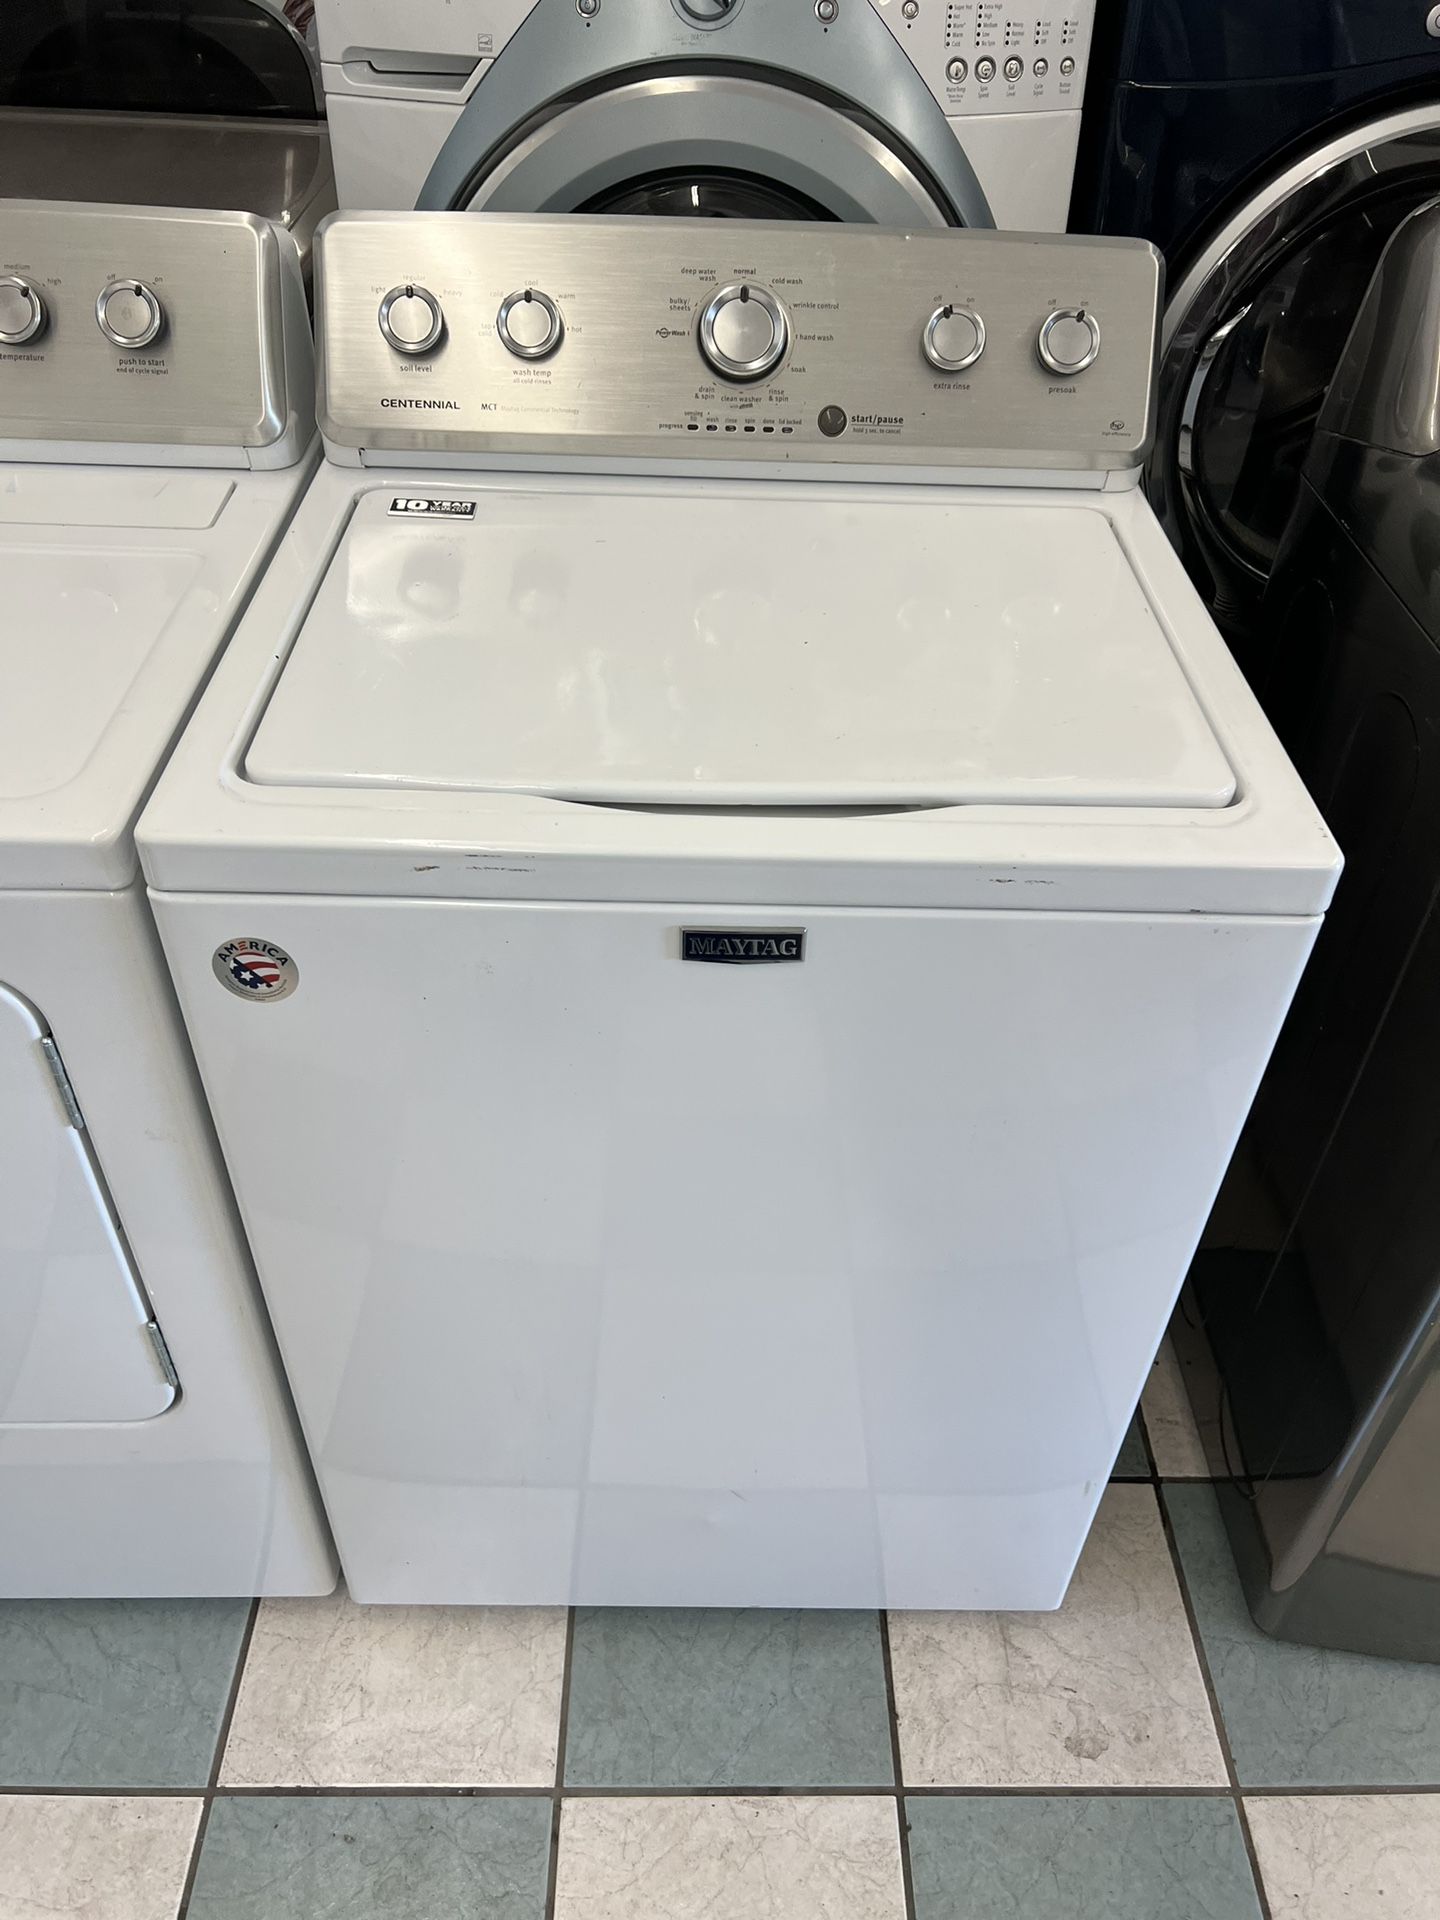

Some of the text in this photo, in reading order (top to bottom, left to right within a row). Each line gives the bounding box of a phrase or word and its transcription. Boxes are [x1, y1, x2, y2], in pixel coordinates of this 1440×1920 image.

[47, 277, 62, 285] high
[0, 353, 44, 362] temperature
[533, 370, 552, 378] temp
[380, 398, 460, 410] CENTENNIAL
[481, 403, 497, 411] MCT
[852, 414, 904, 426] start/pause
[396, 499, 429, 510] 10
[689, 938, 797, 955] MAYTAG
[218, 941, 288, 966] AMERICA
